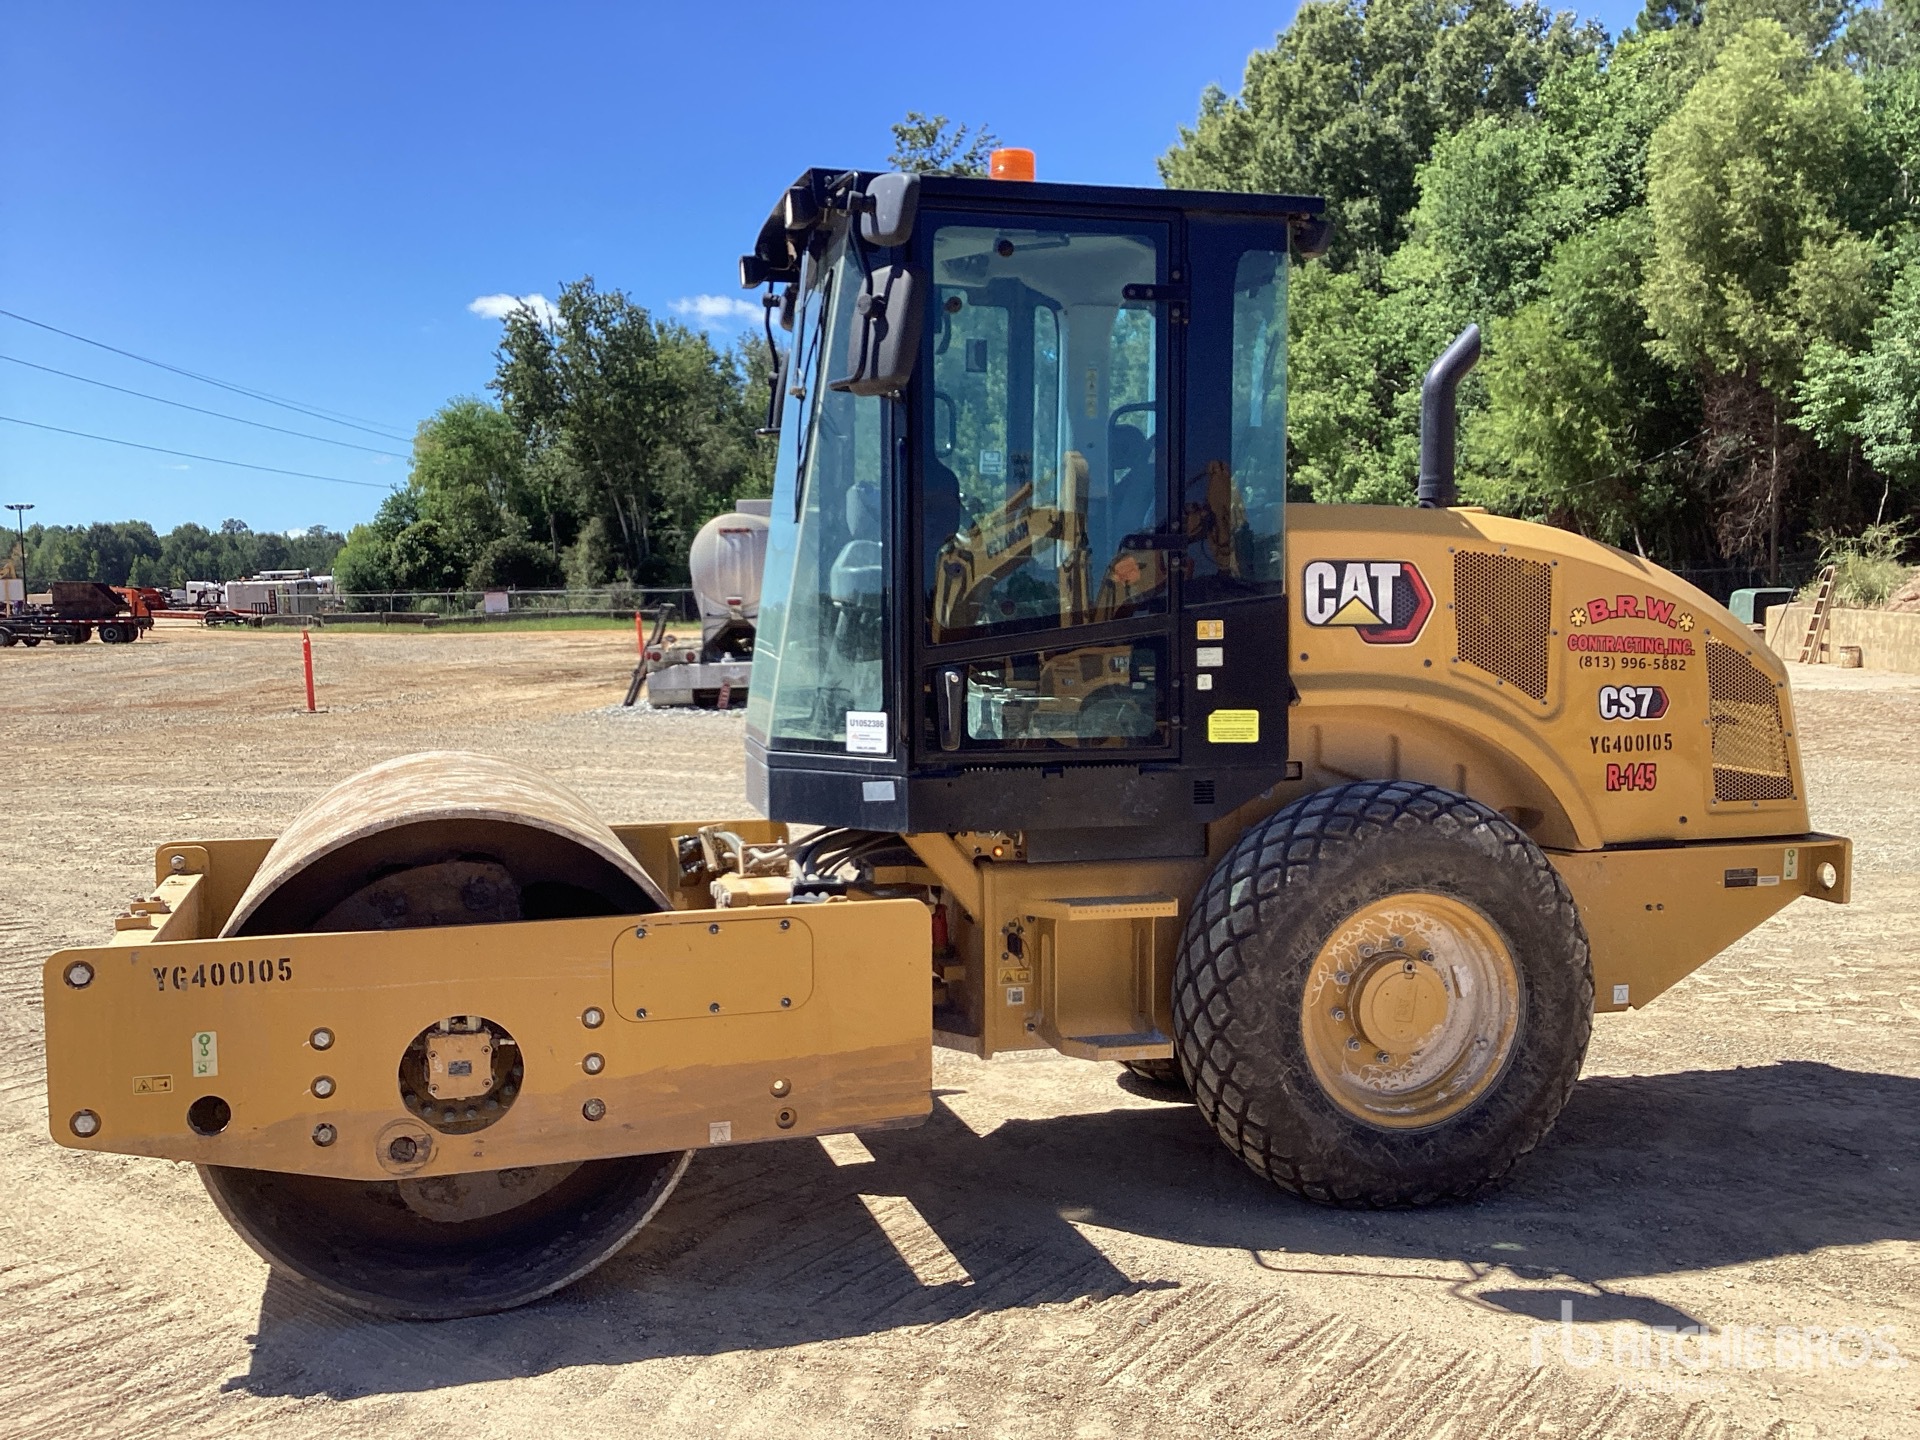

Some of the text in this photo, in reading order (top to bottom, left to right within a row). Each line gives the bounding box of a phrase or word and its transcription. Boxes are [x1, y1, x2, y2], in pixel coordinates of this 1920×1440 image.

[1305, 561, 1401, 625] CAT
[1587, 595, 1678, 629] B.R.W.
[1579, 655, 1686, 671] (813) 996-5882
[1600, 686, 1654, 719] CS7
[1606, 763, 1657, 791] R-145
